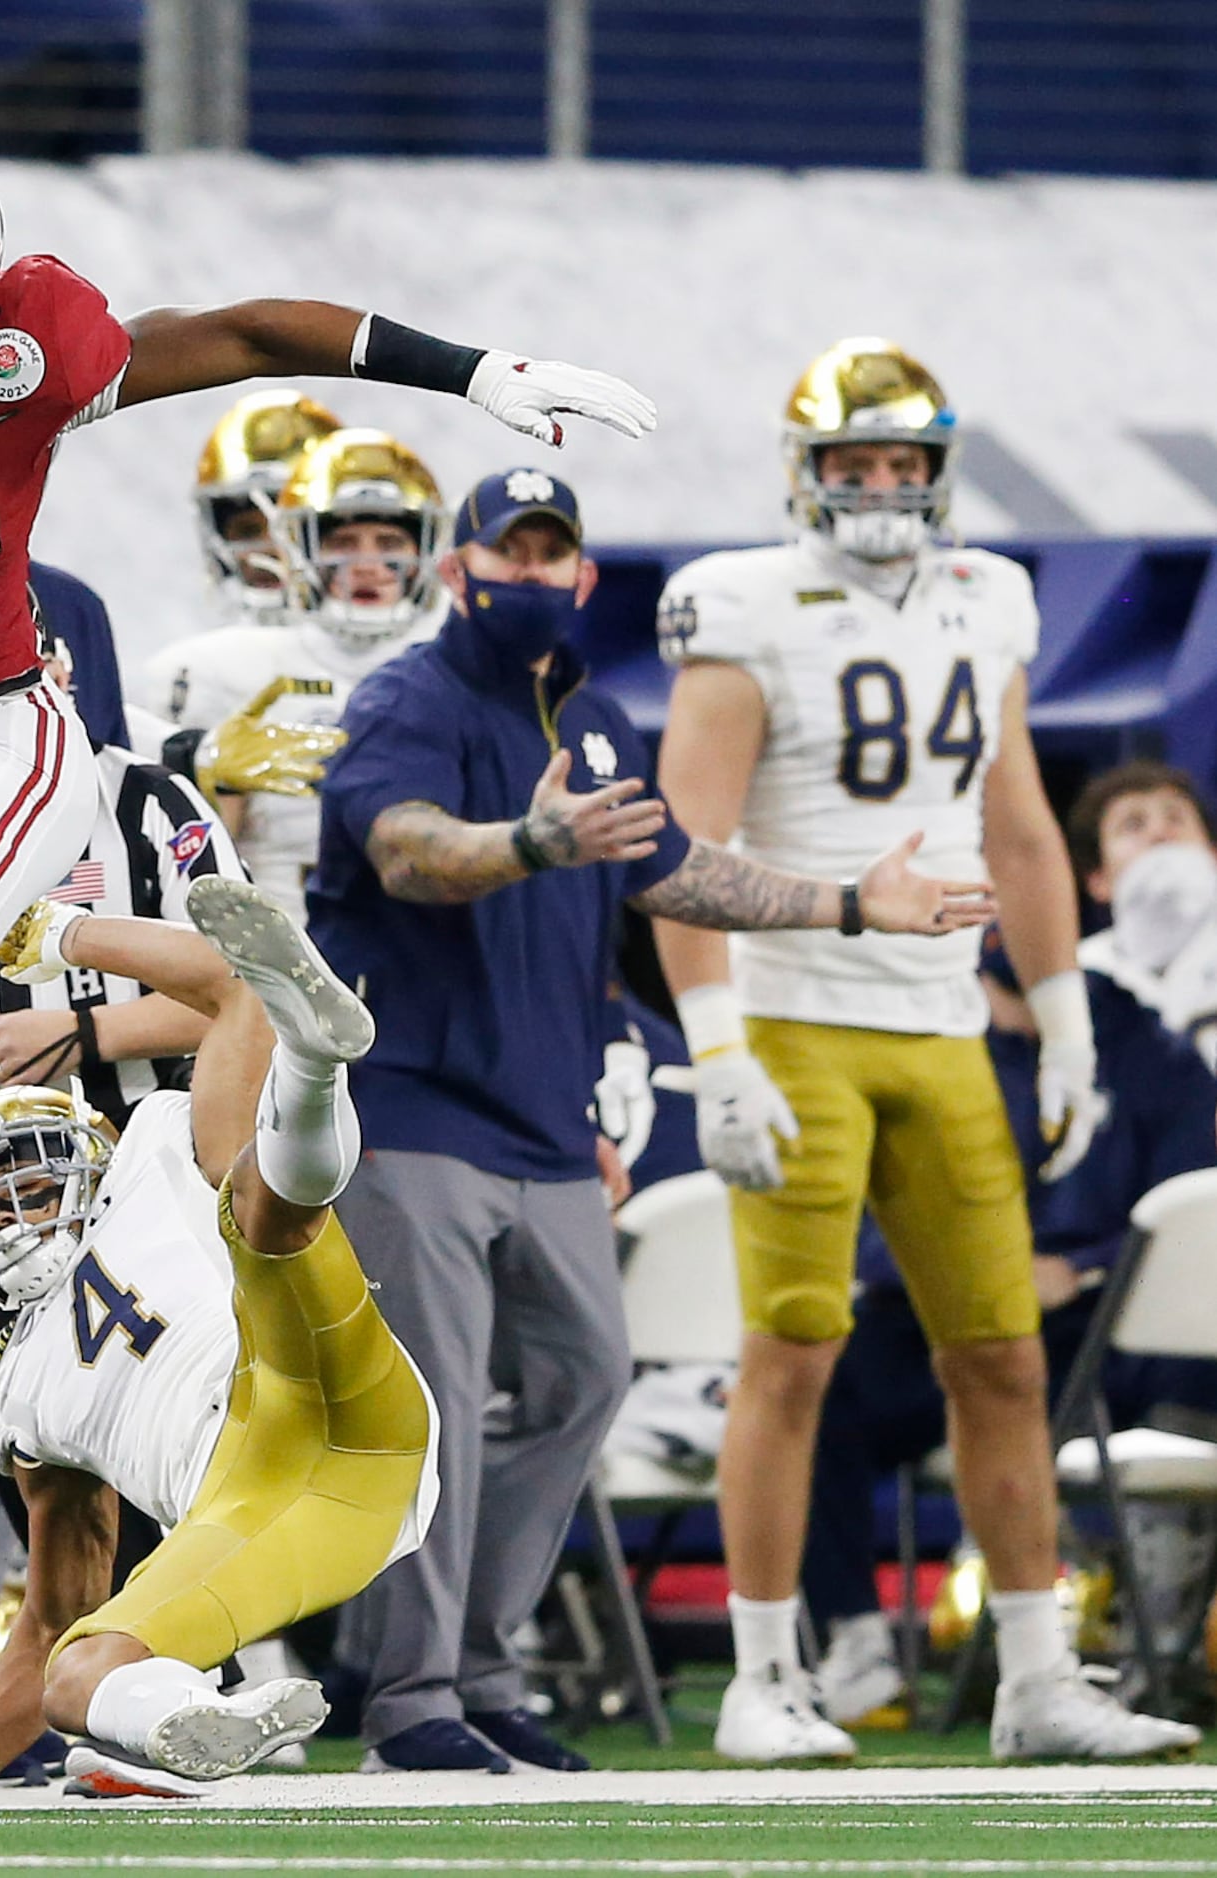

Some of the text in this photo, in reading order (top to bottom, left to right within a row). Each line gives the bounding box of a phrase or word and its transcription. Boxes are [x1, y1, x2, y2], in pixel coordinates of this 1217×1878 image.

[19, 336, 41, 364] GAME
[837, 657, 986, 804] 84
[70, 1244, 171, 1370] 4
